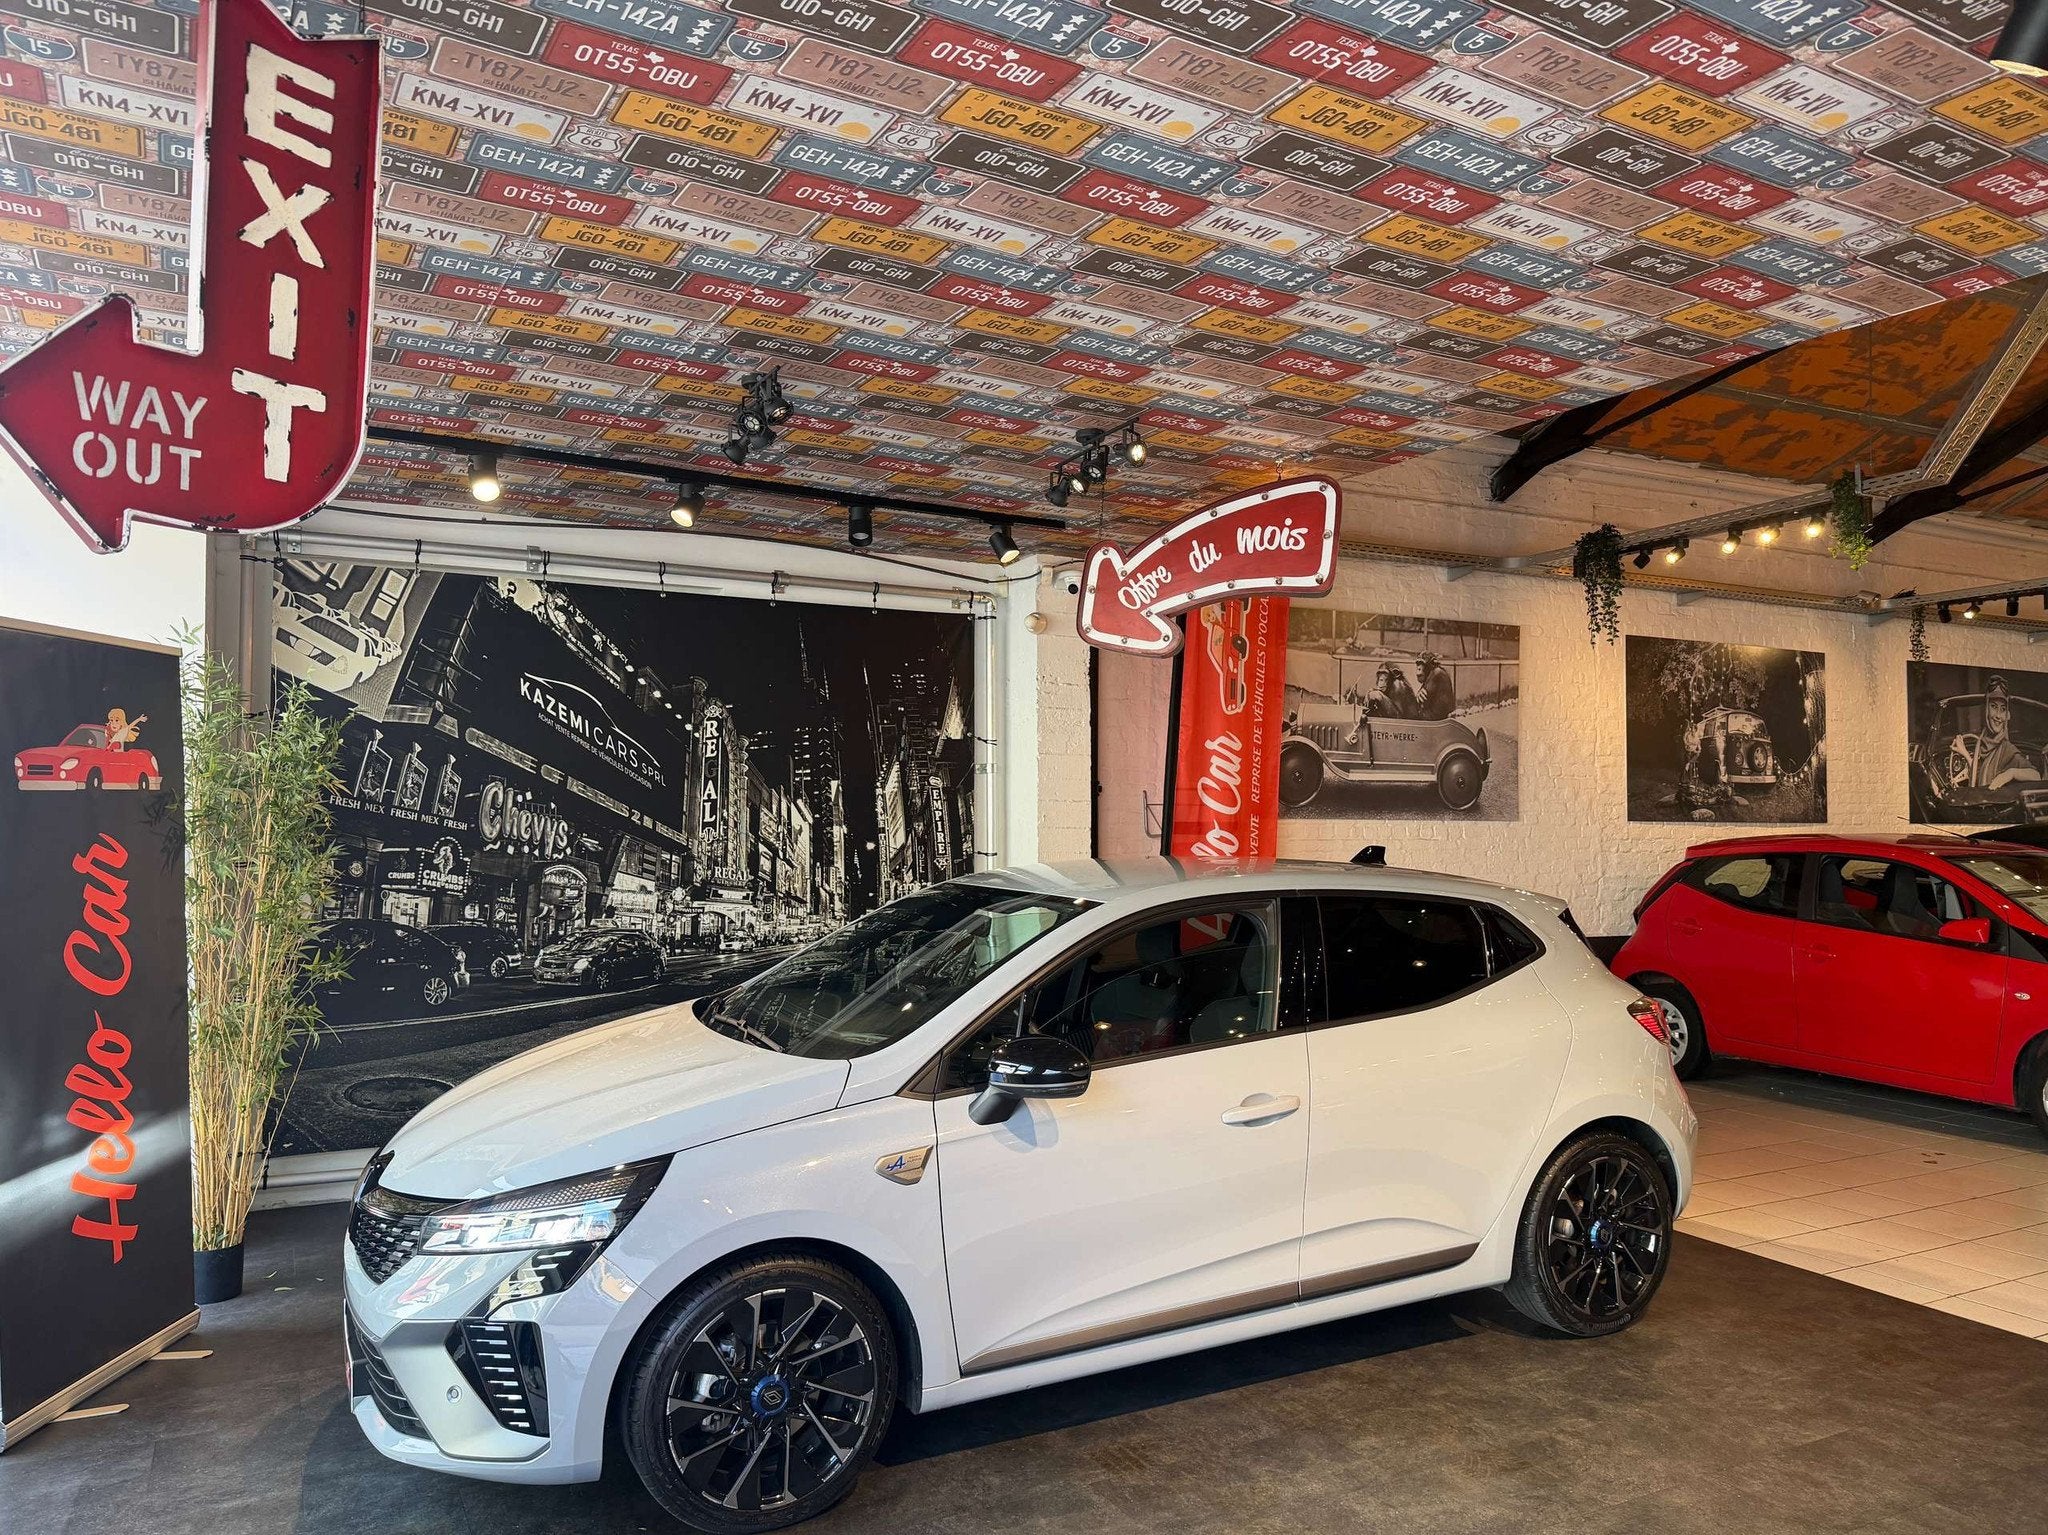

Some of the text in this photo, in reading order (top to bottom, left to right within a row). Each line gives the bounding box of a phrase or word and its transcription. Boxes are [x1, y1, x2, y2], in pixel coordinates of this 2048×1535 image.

[28, 39, 53, 54] 15
[609, 41, 642, 52] TEXAS
[741, 40, 768, 56] 15
[970, 38, 1003, 50] TEXAS
[1100, 38, 1130, 53] 15
[1334, 35, 1366, 47] TEXAS
[1464, 33, 1495, 48] 15
[1701, 31, 1731, 43] TEXAS
[1828, 29, 1862, 45] 15
[666, 103, 744, 125] NEW YORK
[998, 100, 1070, 123] NEW YORK
[1334, 98, 1398, 121] NEW YORK
[1671, 96, 1729, 118] NEW YORK
[580, 135, 603, 147] 66
[896, 134, 921, 146] 66
[1214, 133, 1240, 145] 66
[1535, 129, 1561, 142] 66
[476, 143, 589, 179] GEH-142A
[785, 143, 893, 179] GEH-142A
[1097, 142, 1199, 178] GEH-142A
[1414, 139, 1506, 175] GEH-142A
[1729, 135, 1816, 172] GEH-142A
[231, 44, 335, 483] EXIT
[73, 371, 208, 439] WAY
[72, 430, 202, 491] OUT
[1189, 539, 1222, 574] du
[1236, 517, 1309, 555] mois
[520, 678, 667, 787] KAZEMI CARS SPRL
[1250, 597, 1269, 855] VENTE REPRISE DE VÉHICULES D'OCCA
[703, 720, 719, 823] REGAL
[1197, 730, 1243, 815] Car
[330, 794, 468, 831] FRESH MEX FRESH MEX FRESH
[932, 788, 946, 855] EMPIRE
[388, 872, 415, 880] CRUMBS
[422, 869, 464, 885] CRUMBS
[63, 833, 139, 1264] Hello Car
